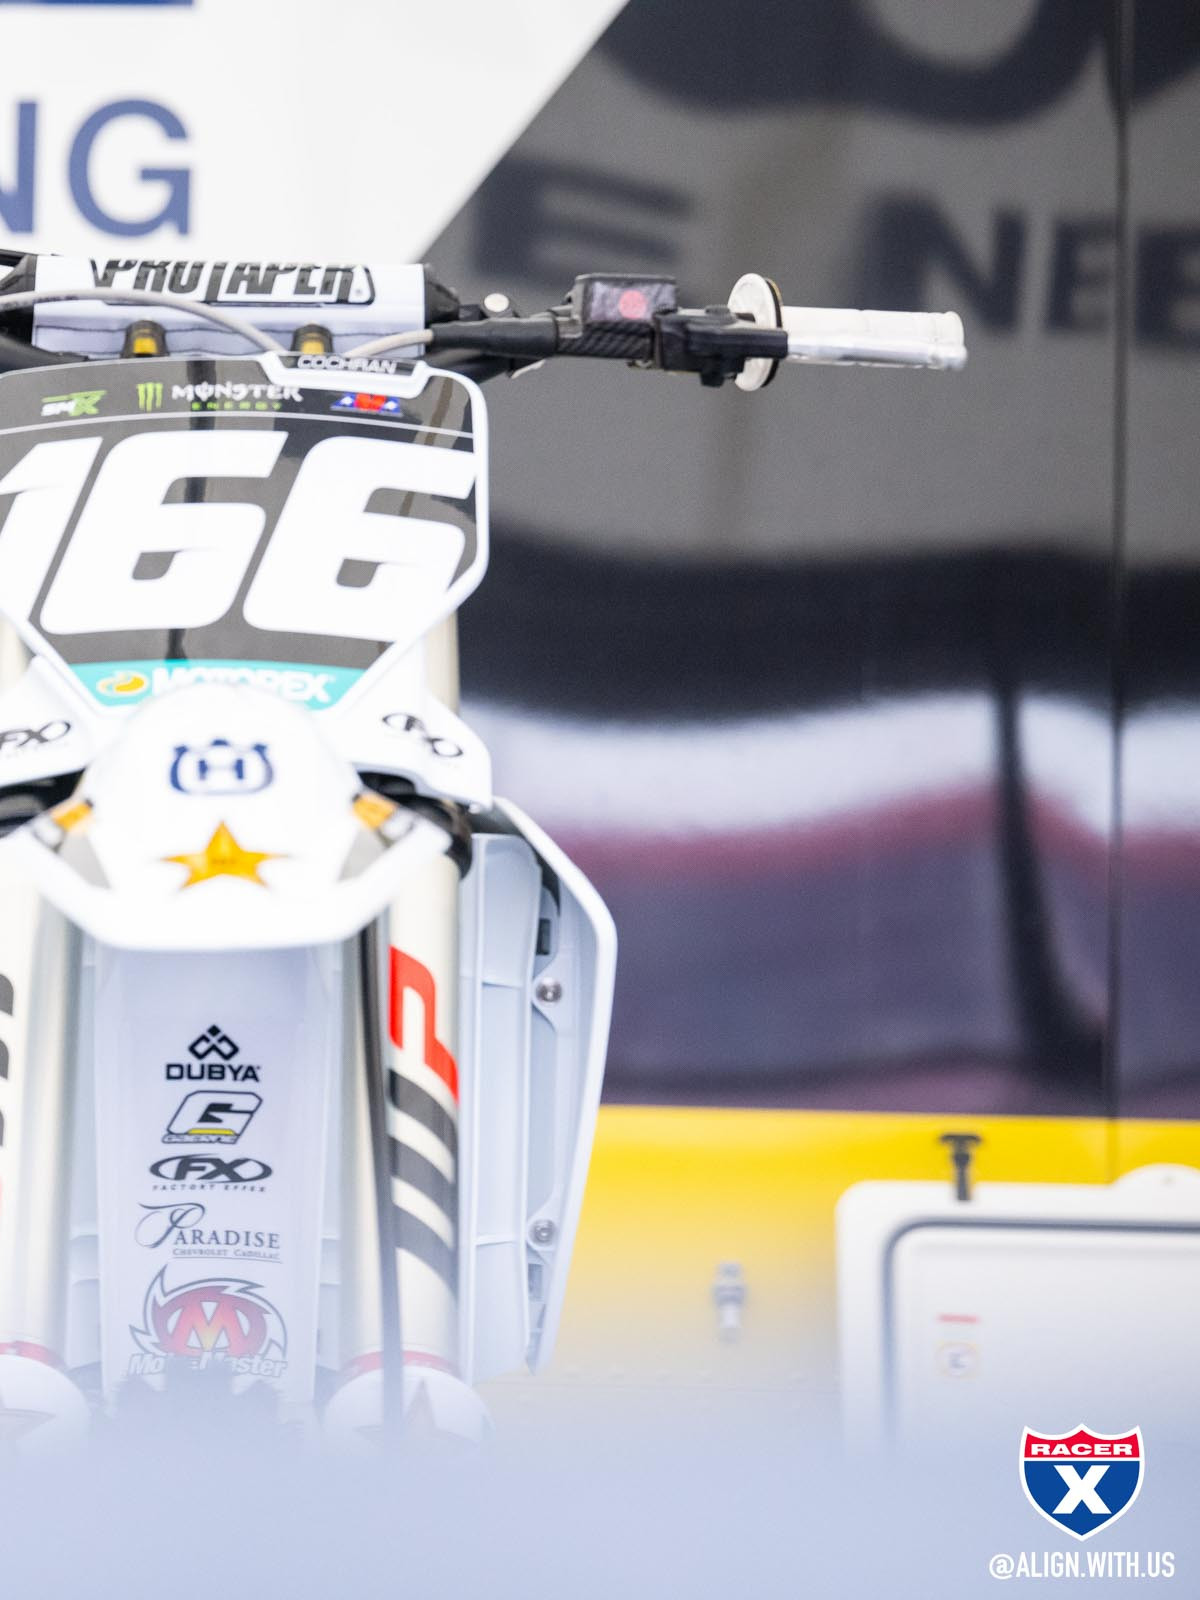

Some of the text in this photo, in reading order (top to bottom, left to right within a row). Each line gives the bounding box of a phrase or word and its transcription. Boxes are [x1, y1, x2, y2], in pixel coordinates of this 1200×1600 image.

[298, 355, 397, 374] COCHRAN
[171, 382, 303, 402] MONSTER
[166, 1063, 259, 1082] DUBYA
[135, 1202, 280, 1249] PARADISE
